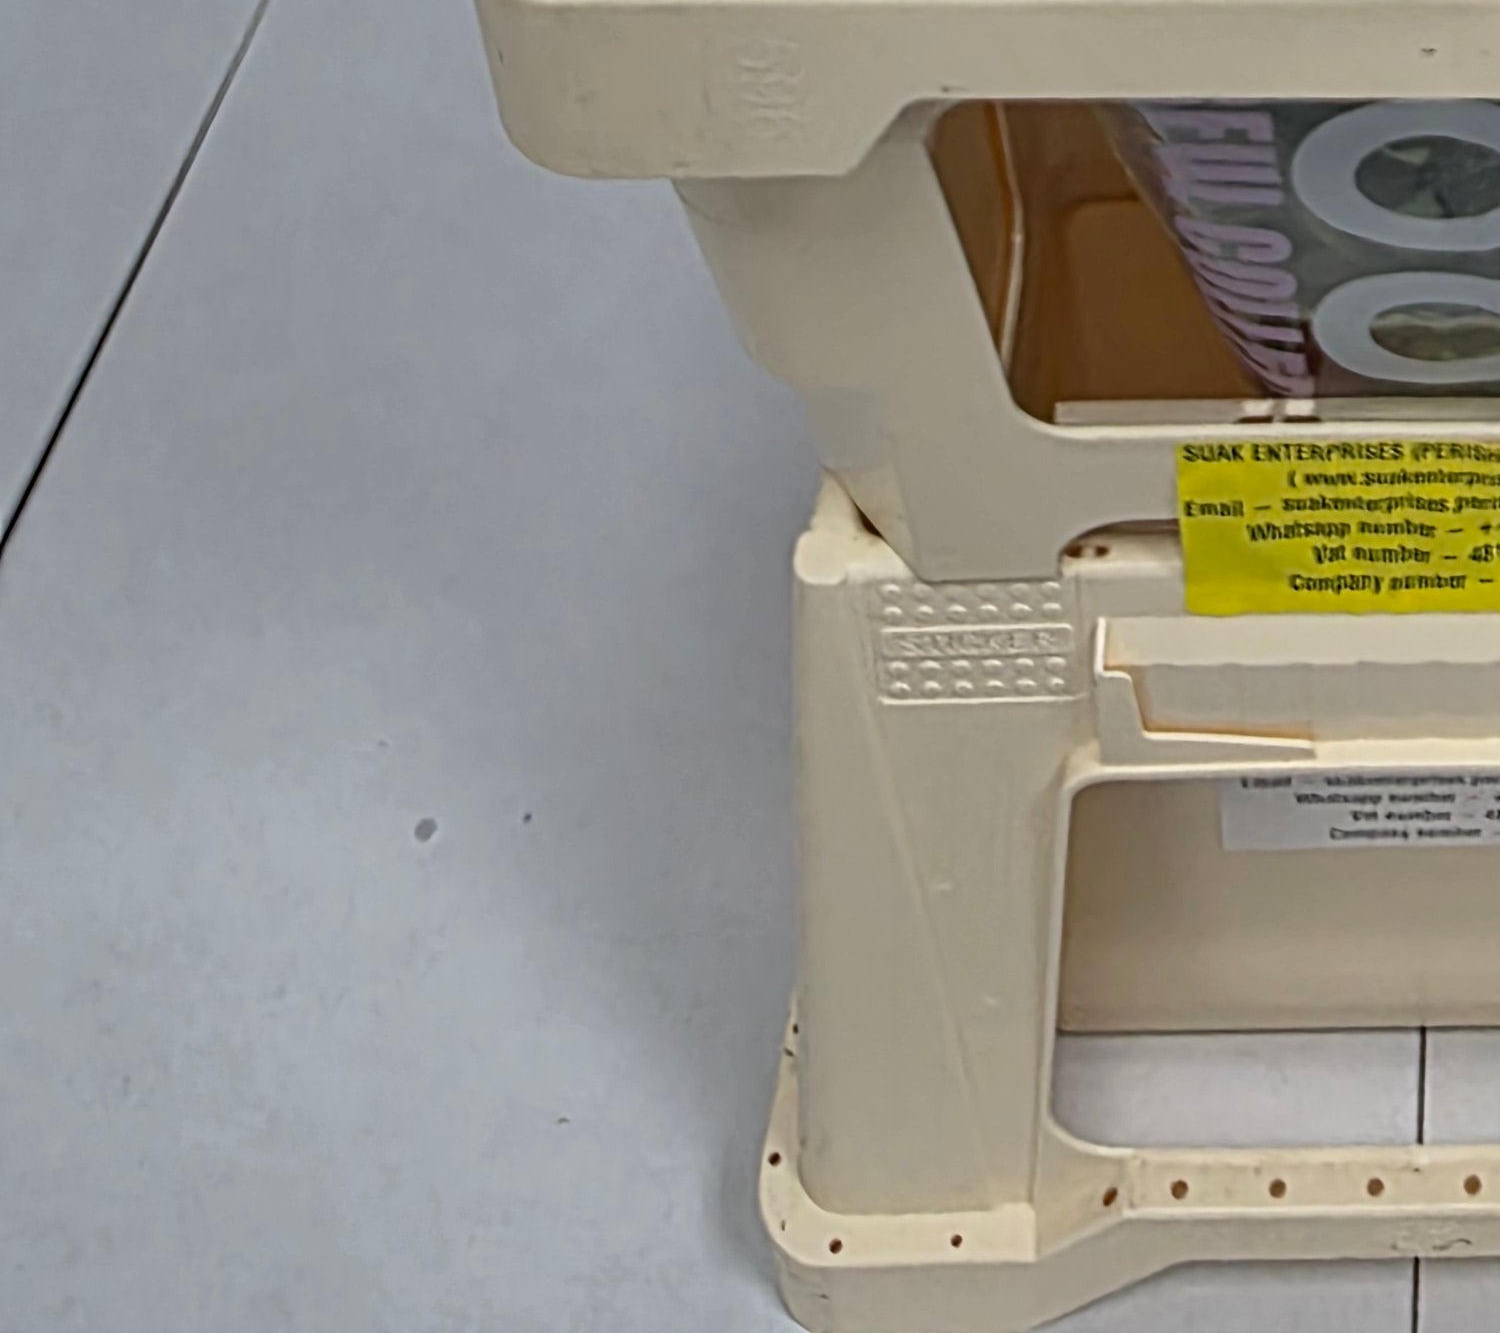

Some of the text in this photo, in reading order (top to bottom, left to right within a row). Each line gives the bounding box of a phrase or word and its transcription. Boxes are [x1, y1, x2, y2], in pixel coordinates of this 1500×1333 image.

[1182, 443, 1245, 463] SUAK
[1252, 442, 1404, 462] ENTERPRISES
[1184, 500, 1245, 518] Email
[1246, 520, 1351, 542] Whatsapp
[1357, 519, 1437, 539] number
[1352, 543, 1431, 564] number
[1288, 573, 1384, 596] Company
[1388, 573, 1467, 592] number
